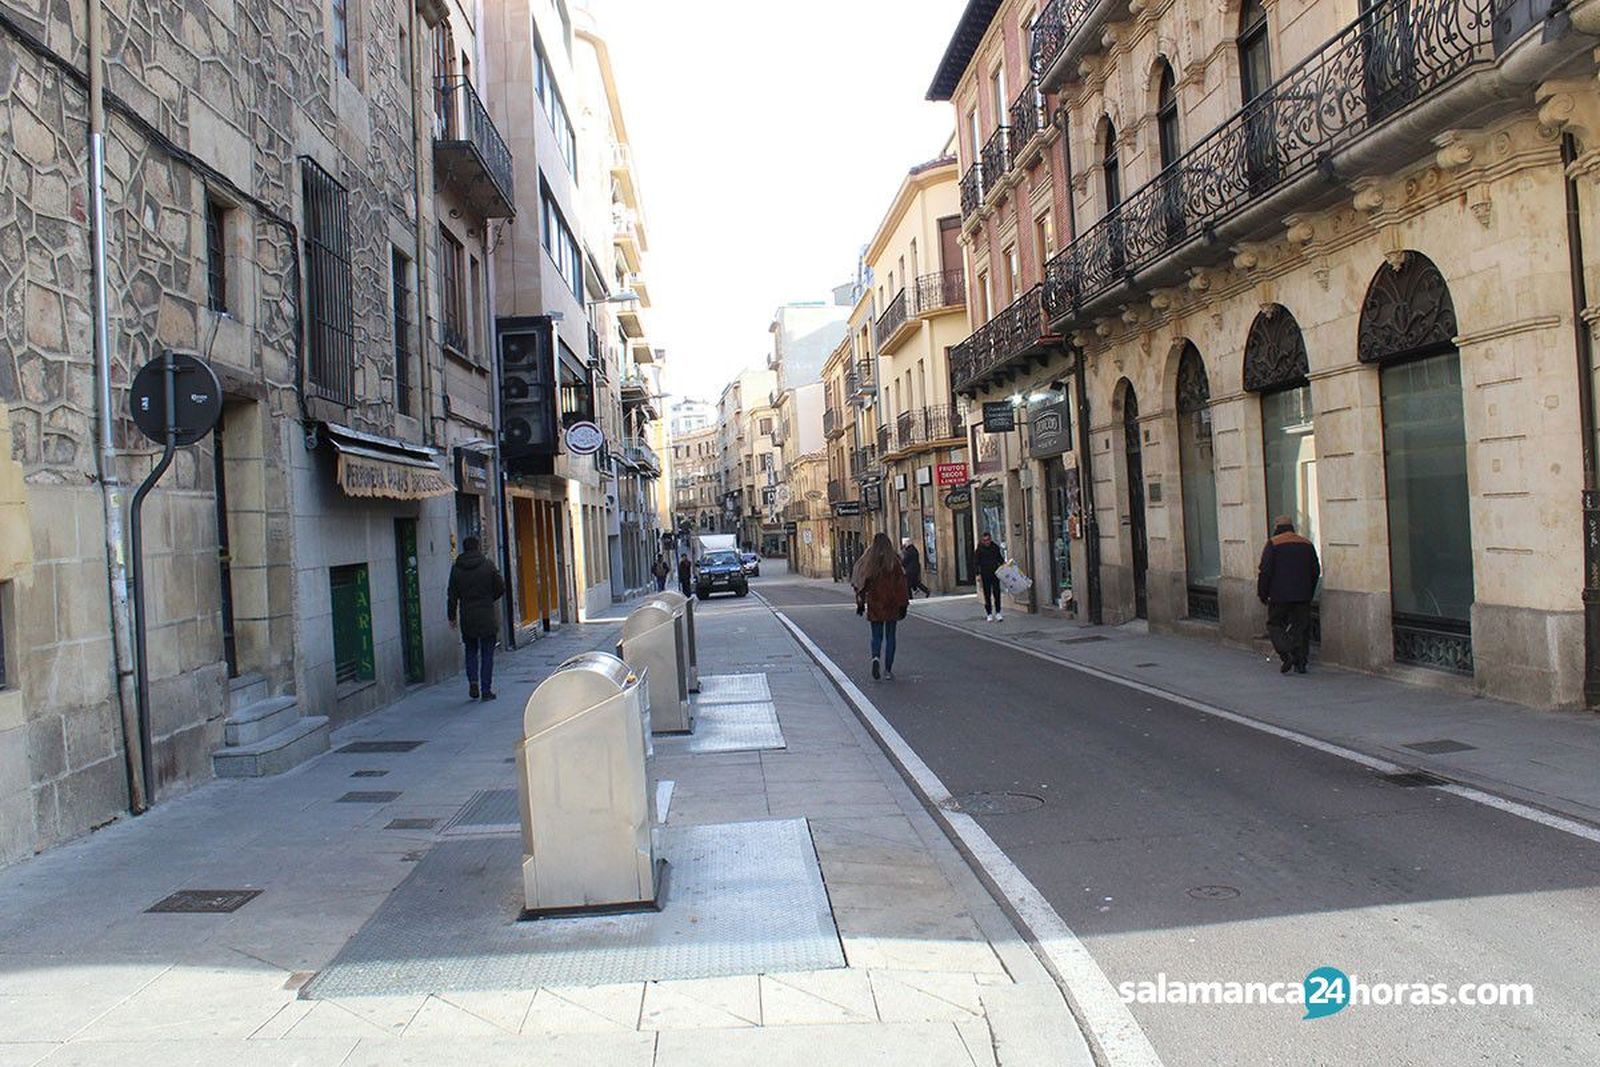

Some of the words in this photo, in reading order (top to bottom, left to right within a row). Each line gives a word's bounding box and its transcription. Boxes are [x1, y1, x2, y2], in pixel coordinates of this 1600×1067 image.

[939, 464, 965, 472] FRUTOS
[941, 471, 964, 479] SECOS
[387, 465, 408, 492] PARIS
[356, 568, 372, 672] PARIS
